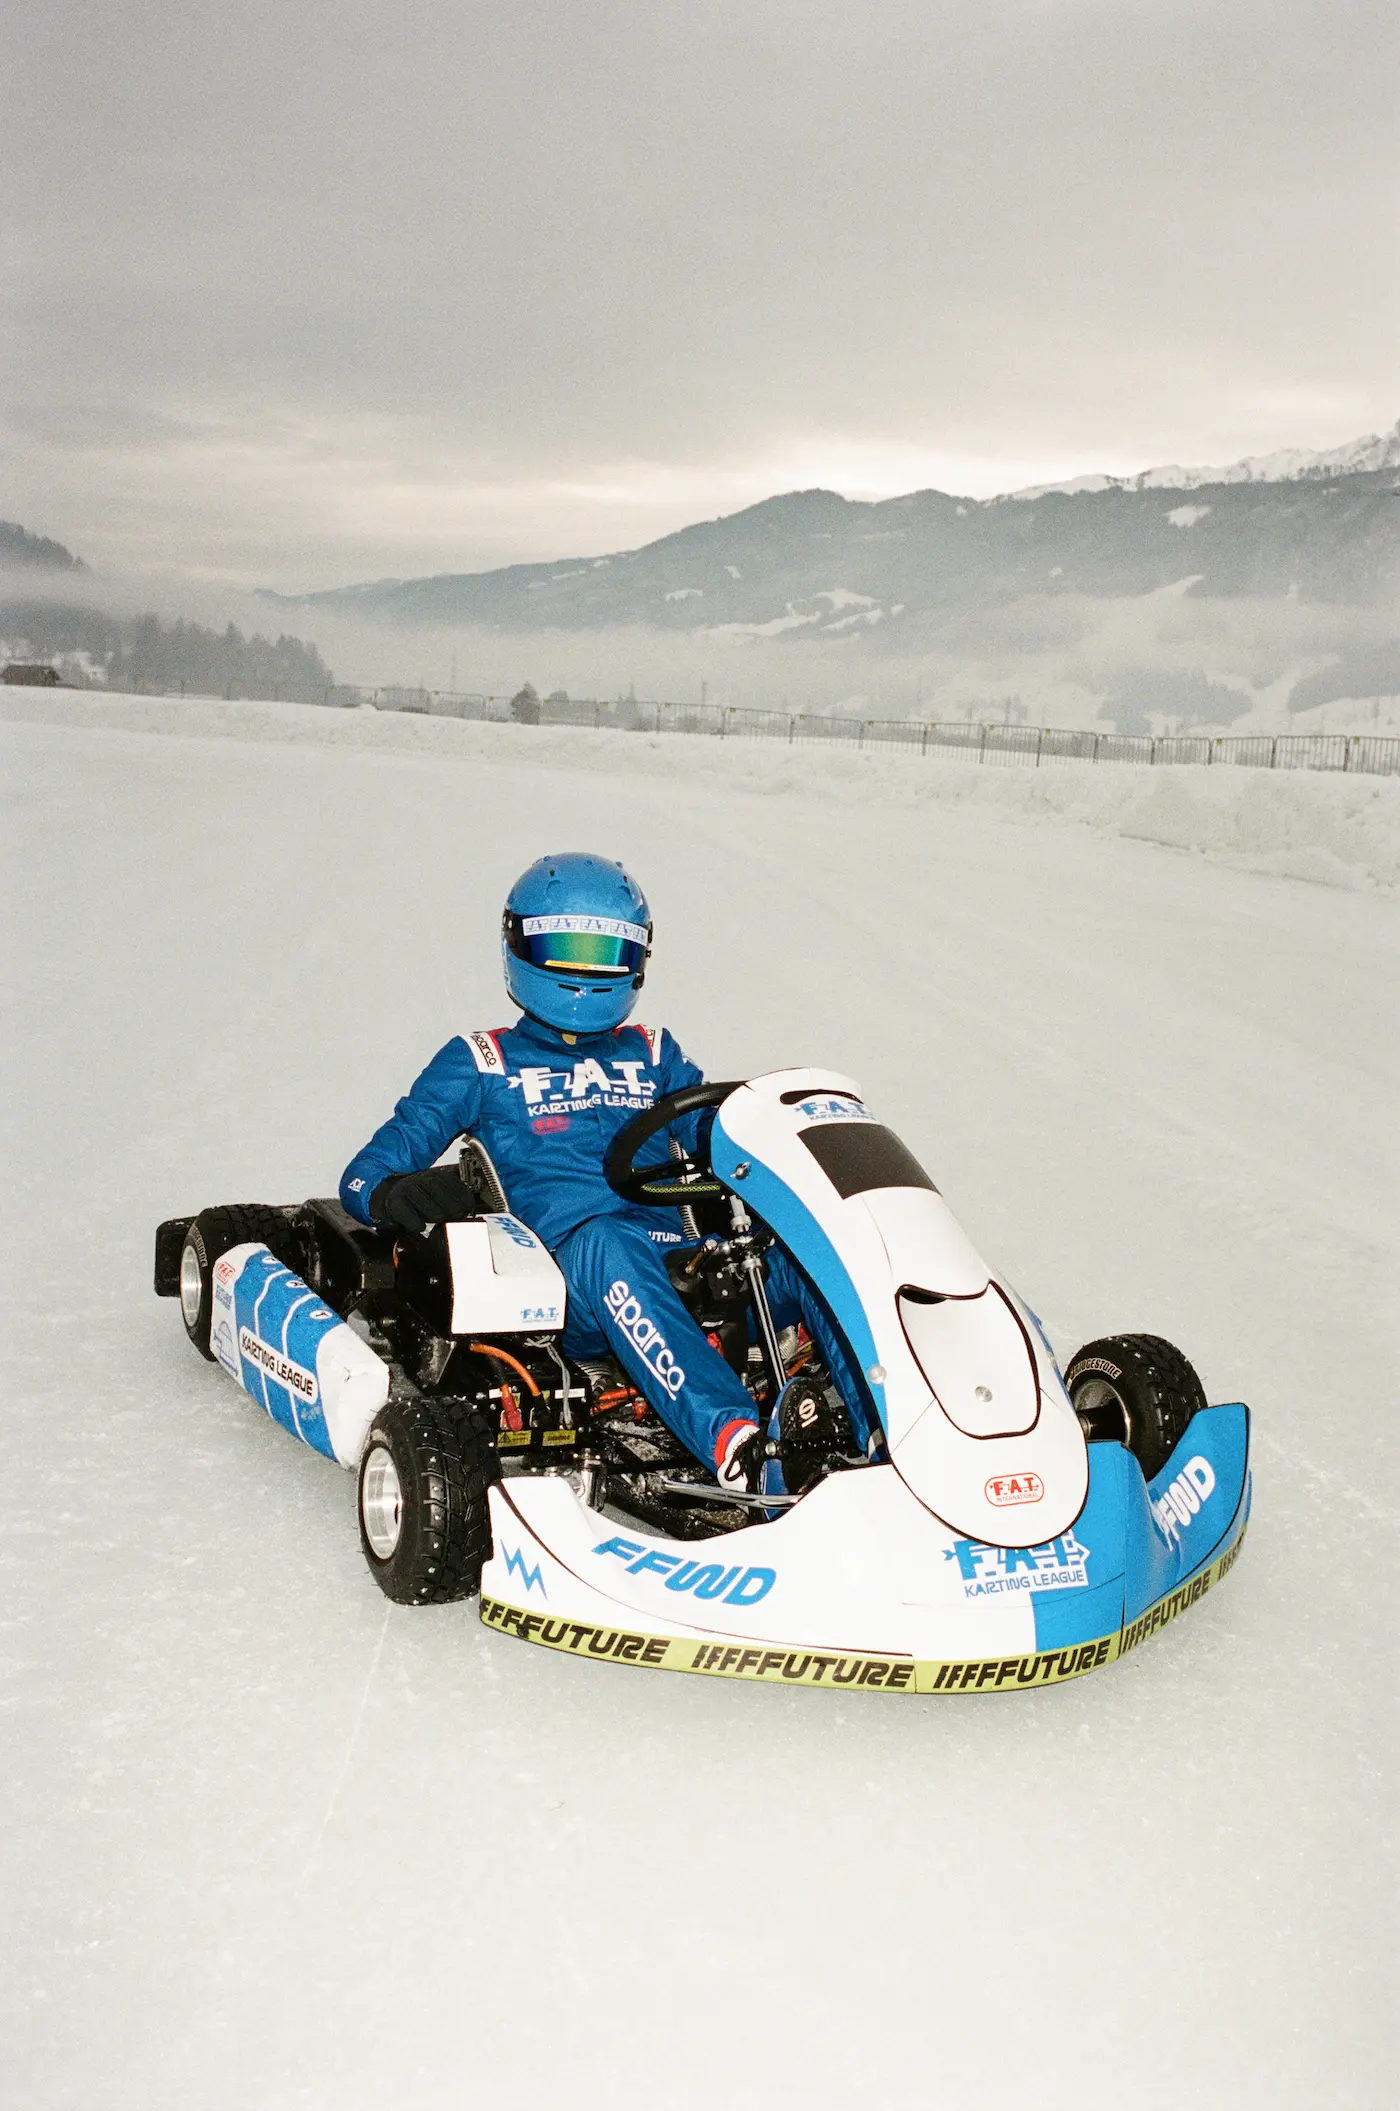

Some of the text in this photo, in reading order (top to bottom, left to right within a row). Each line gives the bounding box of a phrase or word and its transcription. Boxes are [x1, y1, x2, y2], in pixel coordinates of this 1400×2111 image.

[527, 1094, 602, 1117] KARTING
[241, 1333, 314, 1397] KARTING LEAGUE
[604, 1280, 685, 1401] sparco
[591, 1536, 777, 1606] FFWD
[964, 1569, 1085, 1598] KARTING LEAGUE
